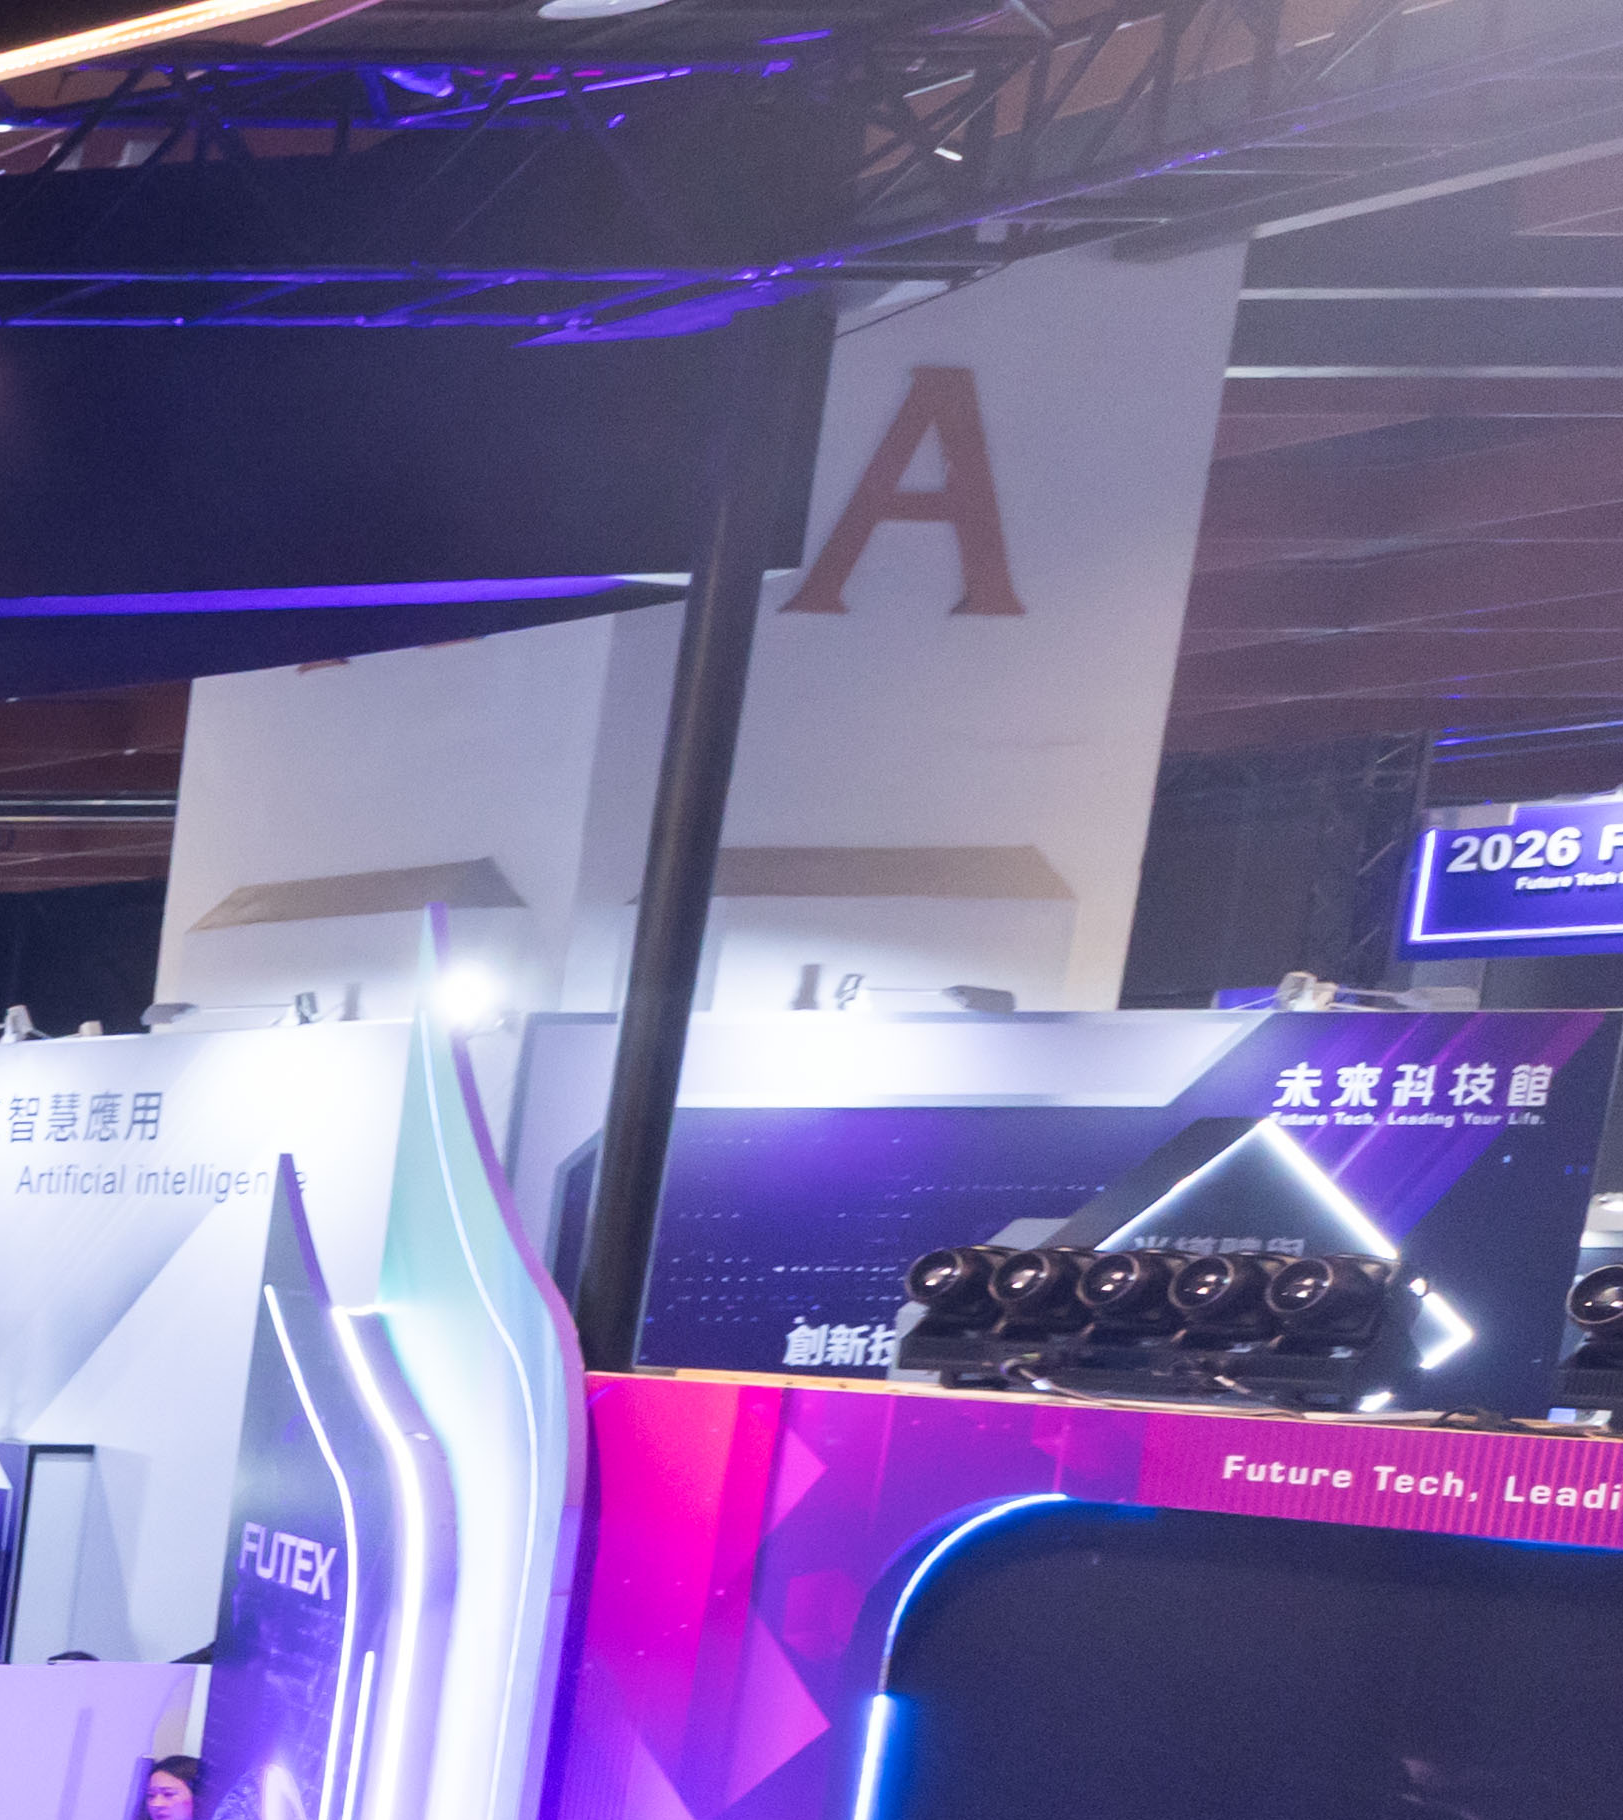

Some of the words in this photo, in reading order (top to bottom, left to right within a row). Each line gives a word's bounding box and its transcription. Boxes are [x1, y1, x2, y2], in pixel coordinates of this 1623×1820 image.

[778, 366, 1027, 617] A
[1446, 826, 1582, 873] 2026
[1515, 873, 1573, 891] Future
[1272, 1063, 1551, 1108] 未來科技館
[1386, 1112, 1454, 1129] Leading
[1463, 1112, 1501, 1127] Your
[16, 1164, 126, 1196] Artificial
[1223, 1454, 1352, 1492] Future
[1373, 1466, 1481, 1504] Tech,
[238, 1521, 339, 1600] FUTEX
